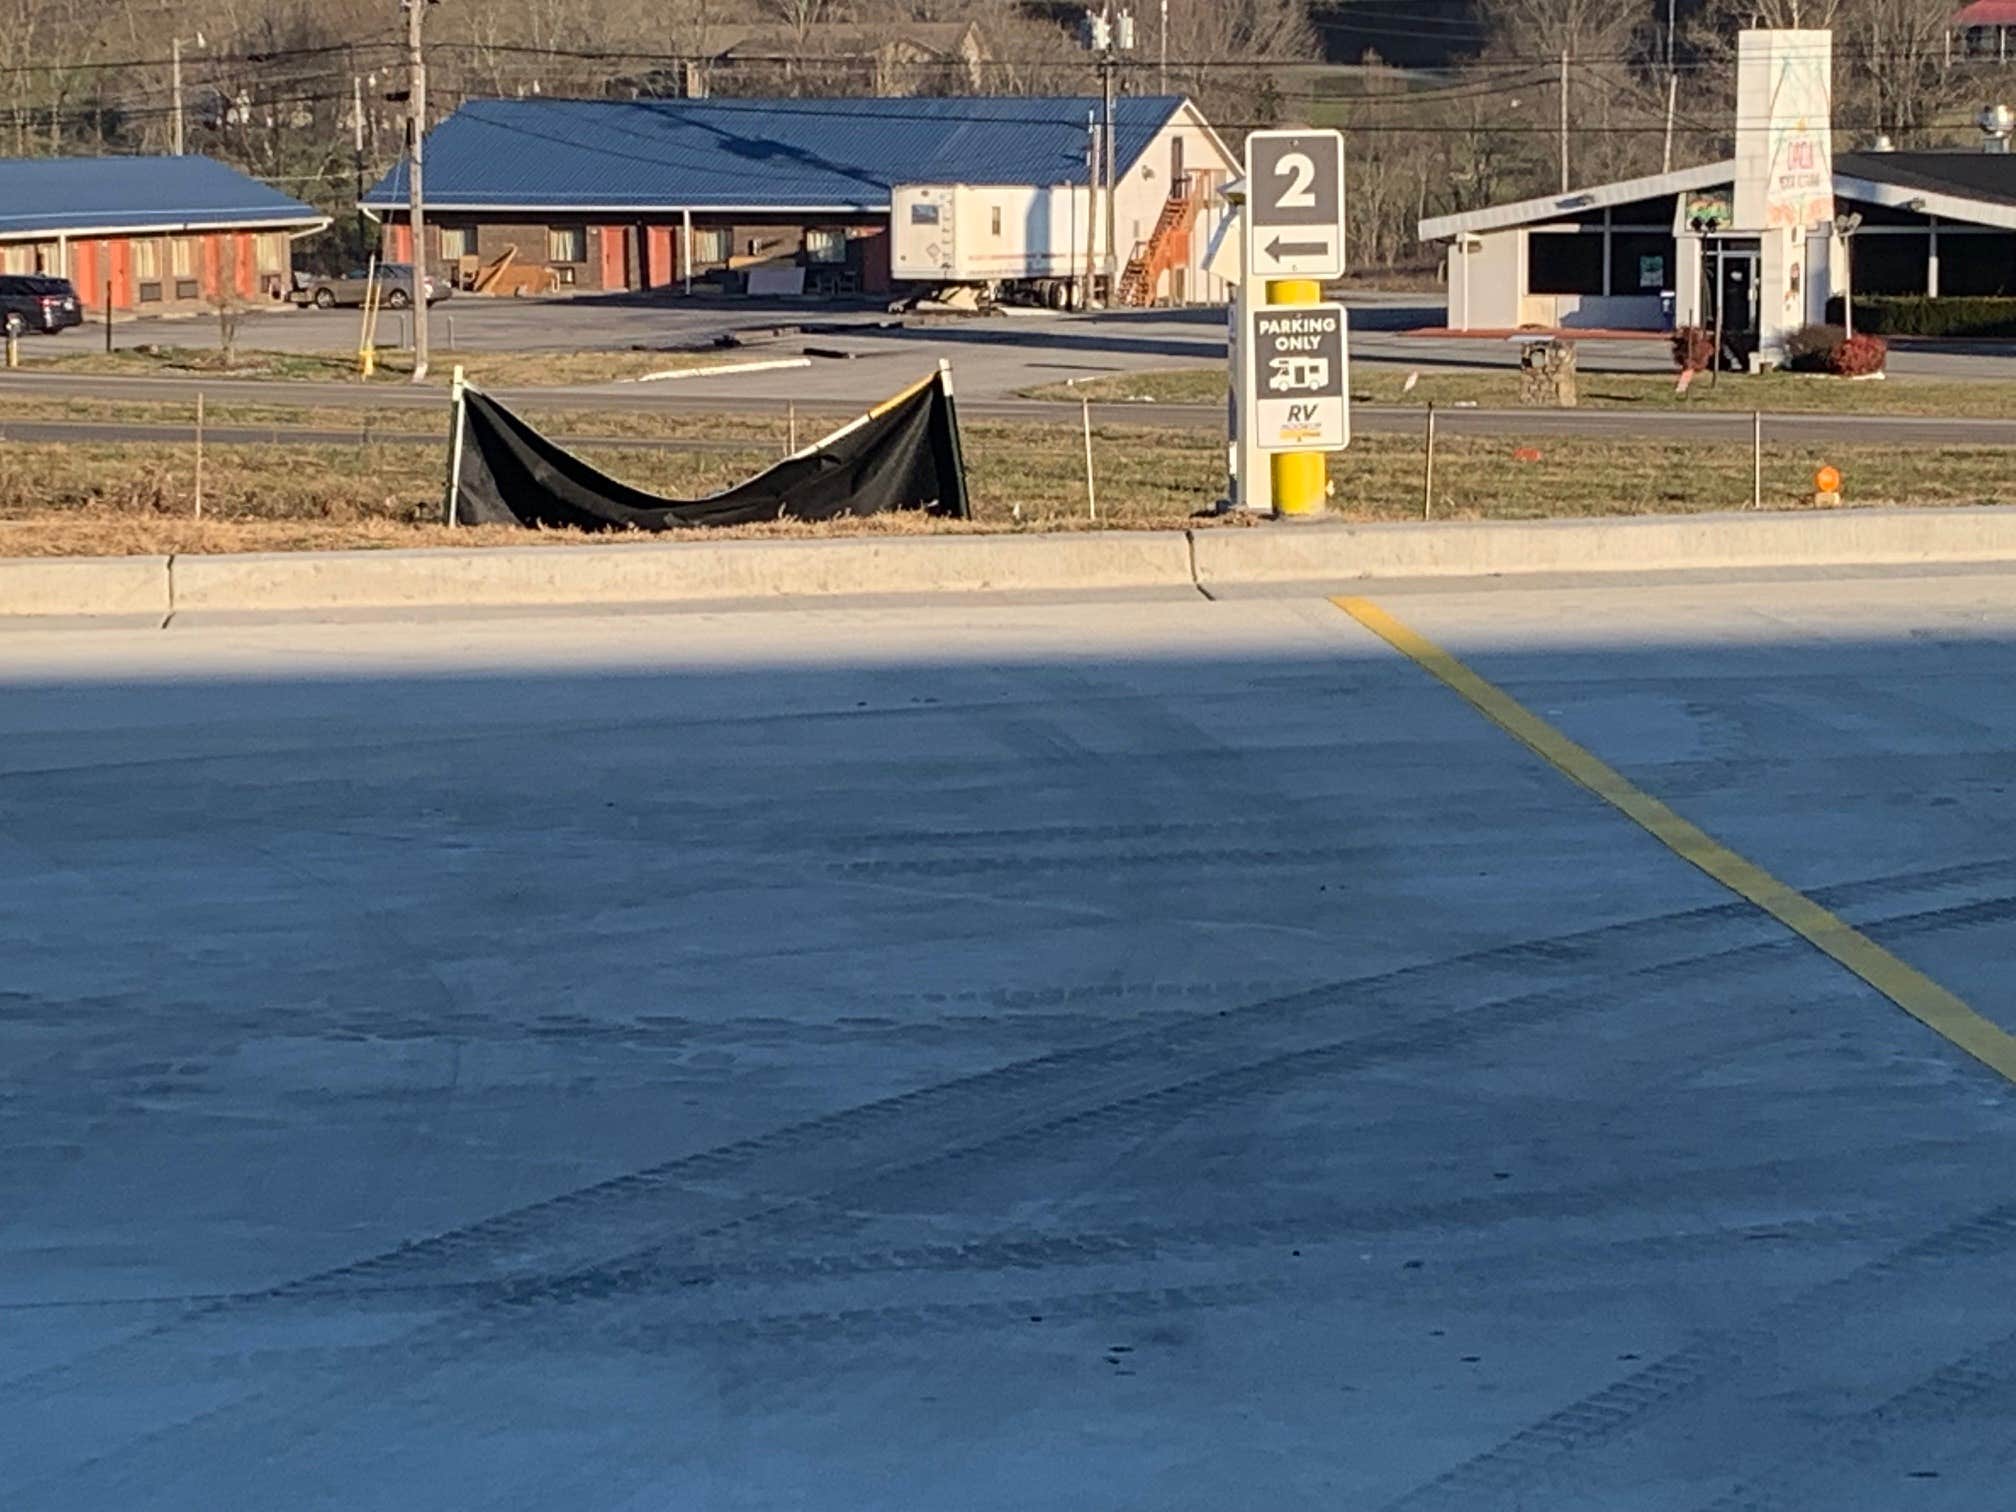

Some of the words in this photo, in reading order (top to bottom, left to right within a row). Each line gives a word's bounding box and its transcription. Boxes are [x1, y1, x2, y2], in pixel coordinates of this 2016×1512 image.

[1275, 153, 1315, 207] 2
[1259, 318, 1336, 335] PARKING
[1275, 335, 1322, 351] ONLY
[1287, 403, 1319, 422] RV
